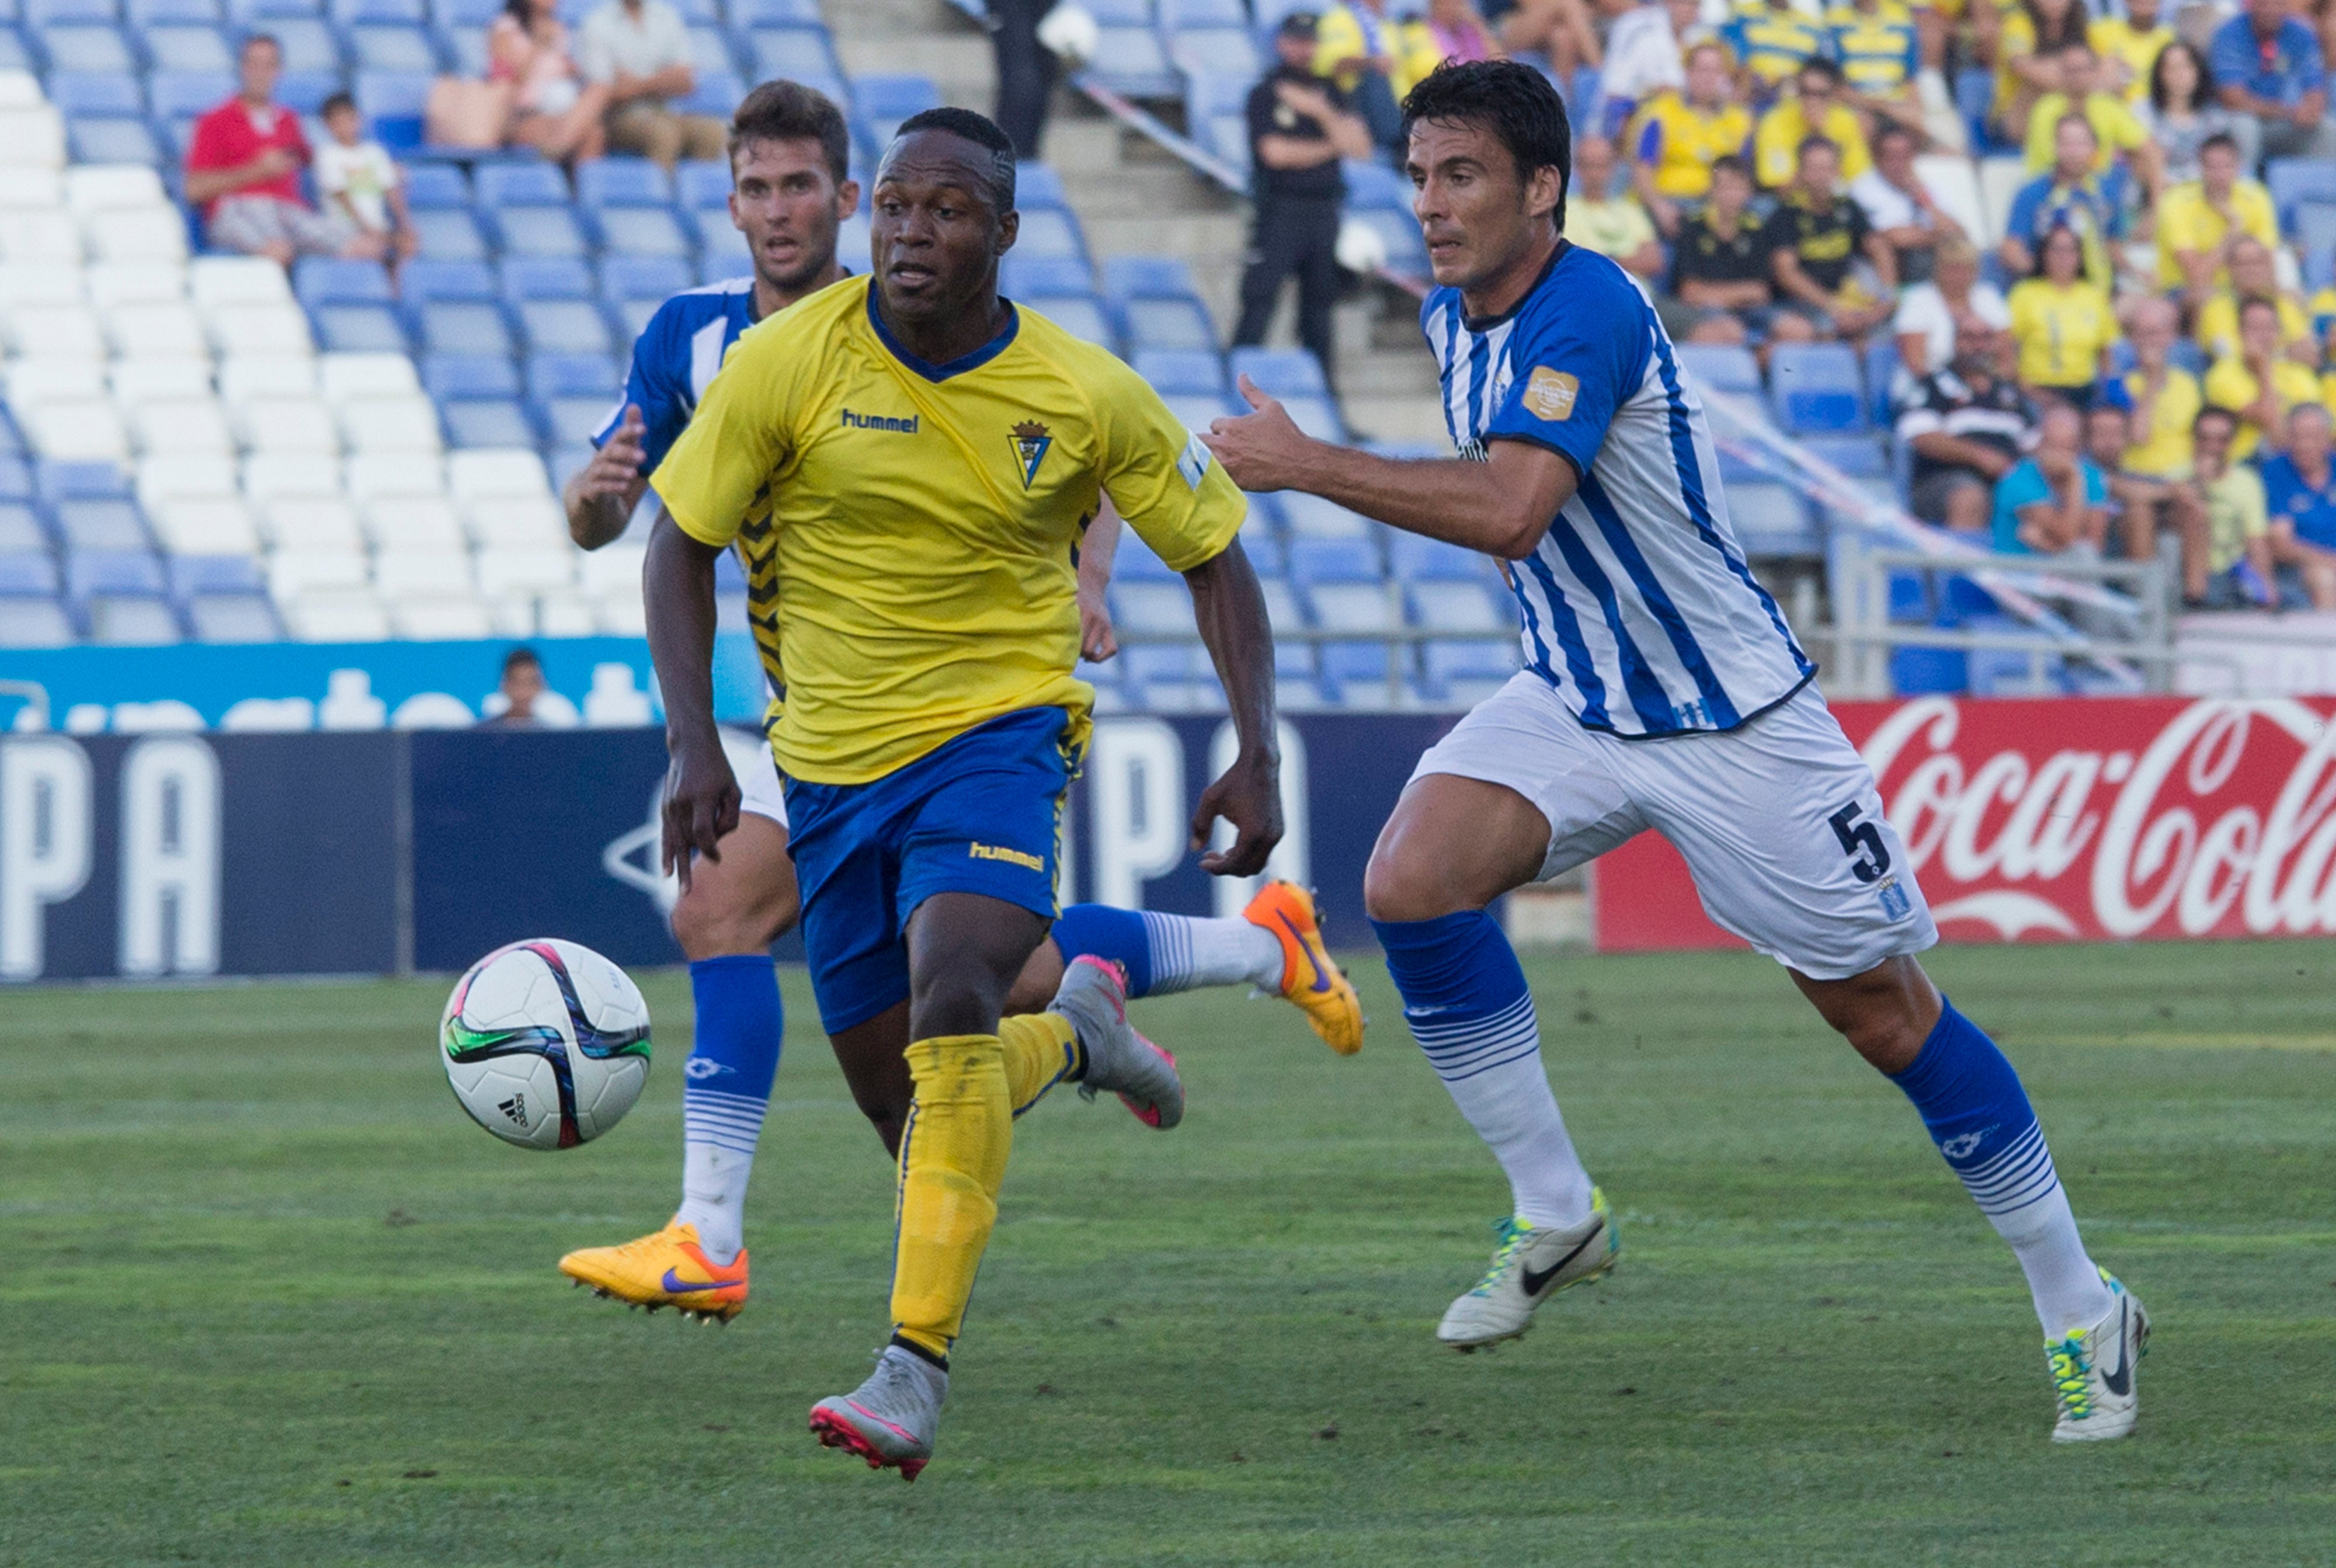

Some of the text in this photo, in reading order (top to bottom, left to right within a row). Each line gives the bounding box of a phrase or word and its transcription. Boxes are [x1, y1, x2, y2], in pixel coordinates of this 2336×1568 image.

[842, 408, 919, 433] hummel
[969, 841, 1044, 872] hummel
[1827, 800, 1891, 883] 5
